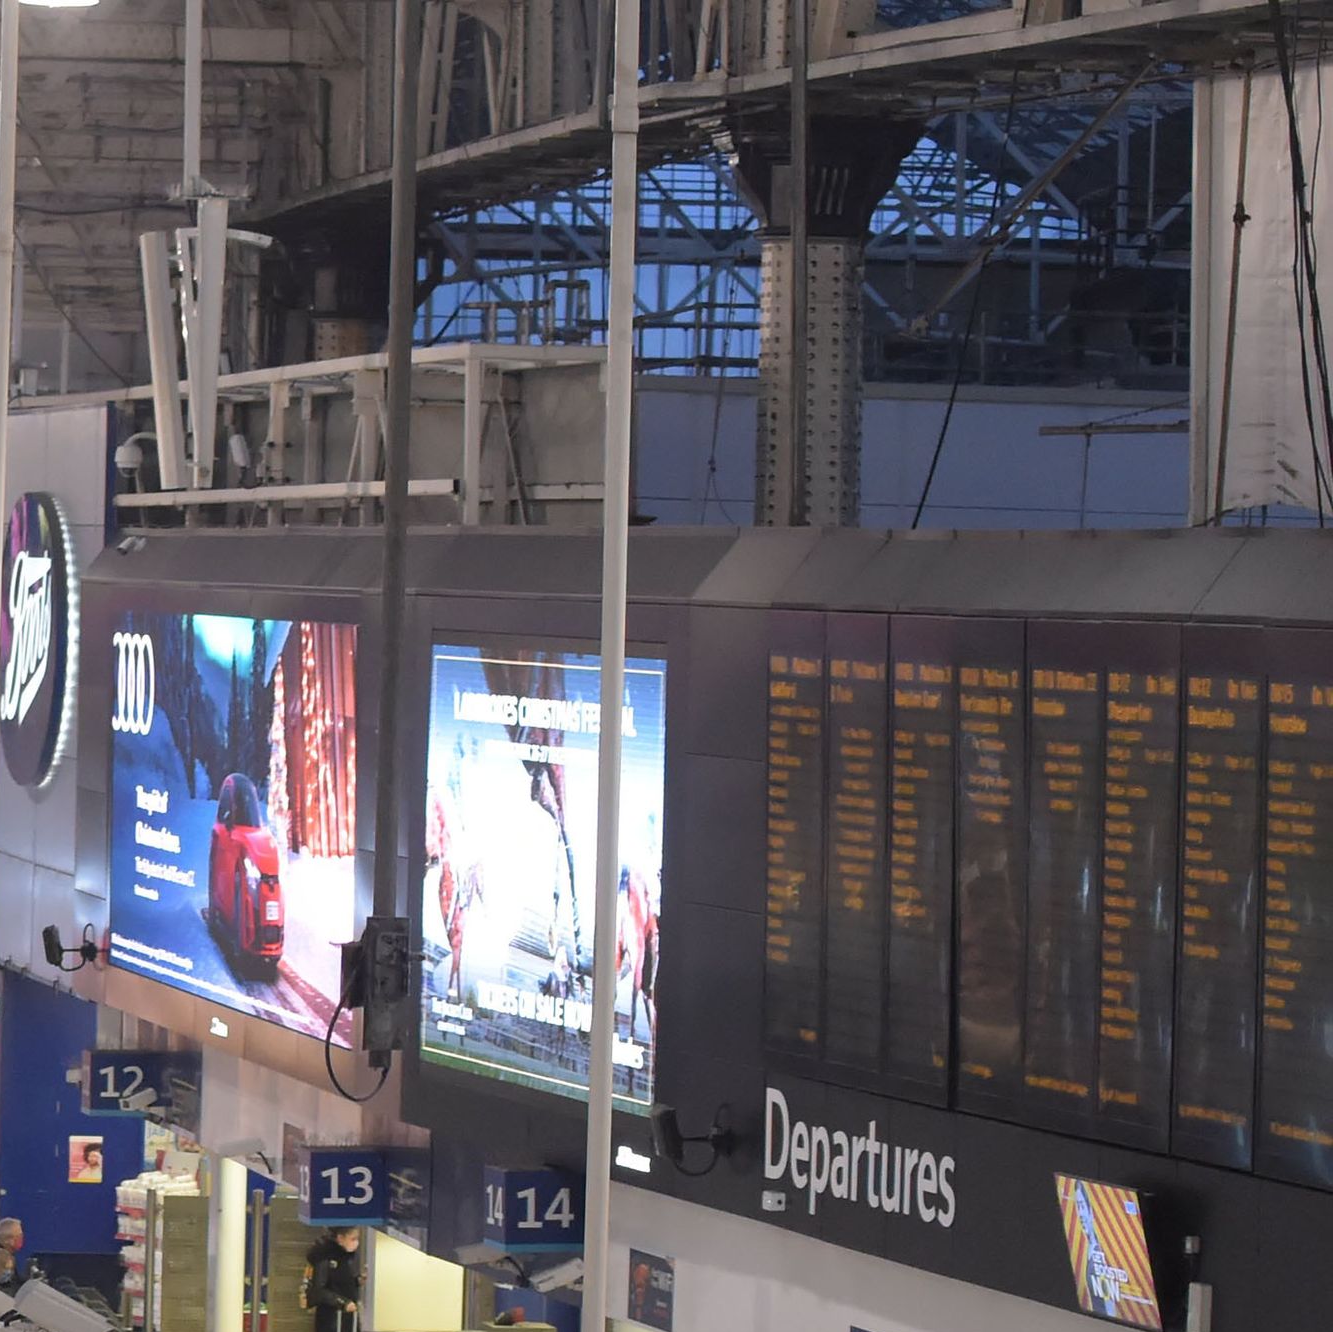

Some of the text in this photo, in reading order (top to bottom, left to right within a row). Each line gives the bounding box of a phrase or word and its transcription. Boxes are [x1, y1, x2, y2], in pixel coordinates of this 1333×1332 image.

[0, 550, 52, 727] Boots
[98, 1066, 144, 1098] 12
[764, 1086, 957, 1228] Departures
[320, 1166, 374, 1206] 13
[485, 1183, 575, 1229] 14 14
[1090, 1274, 1121, 1302] NOW
